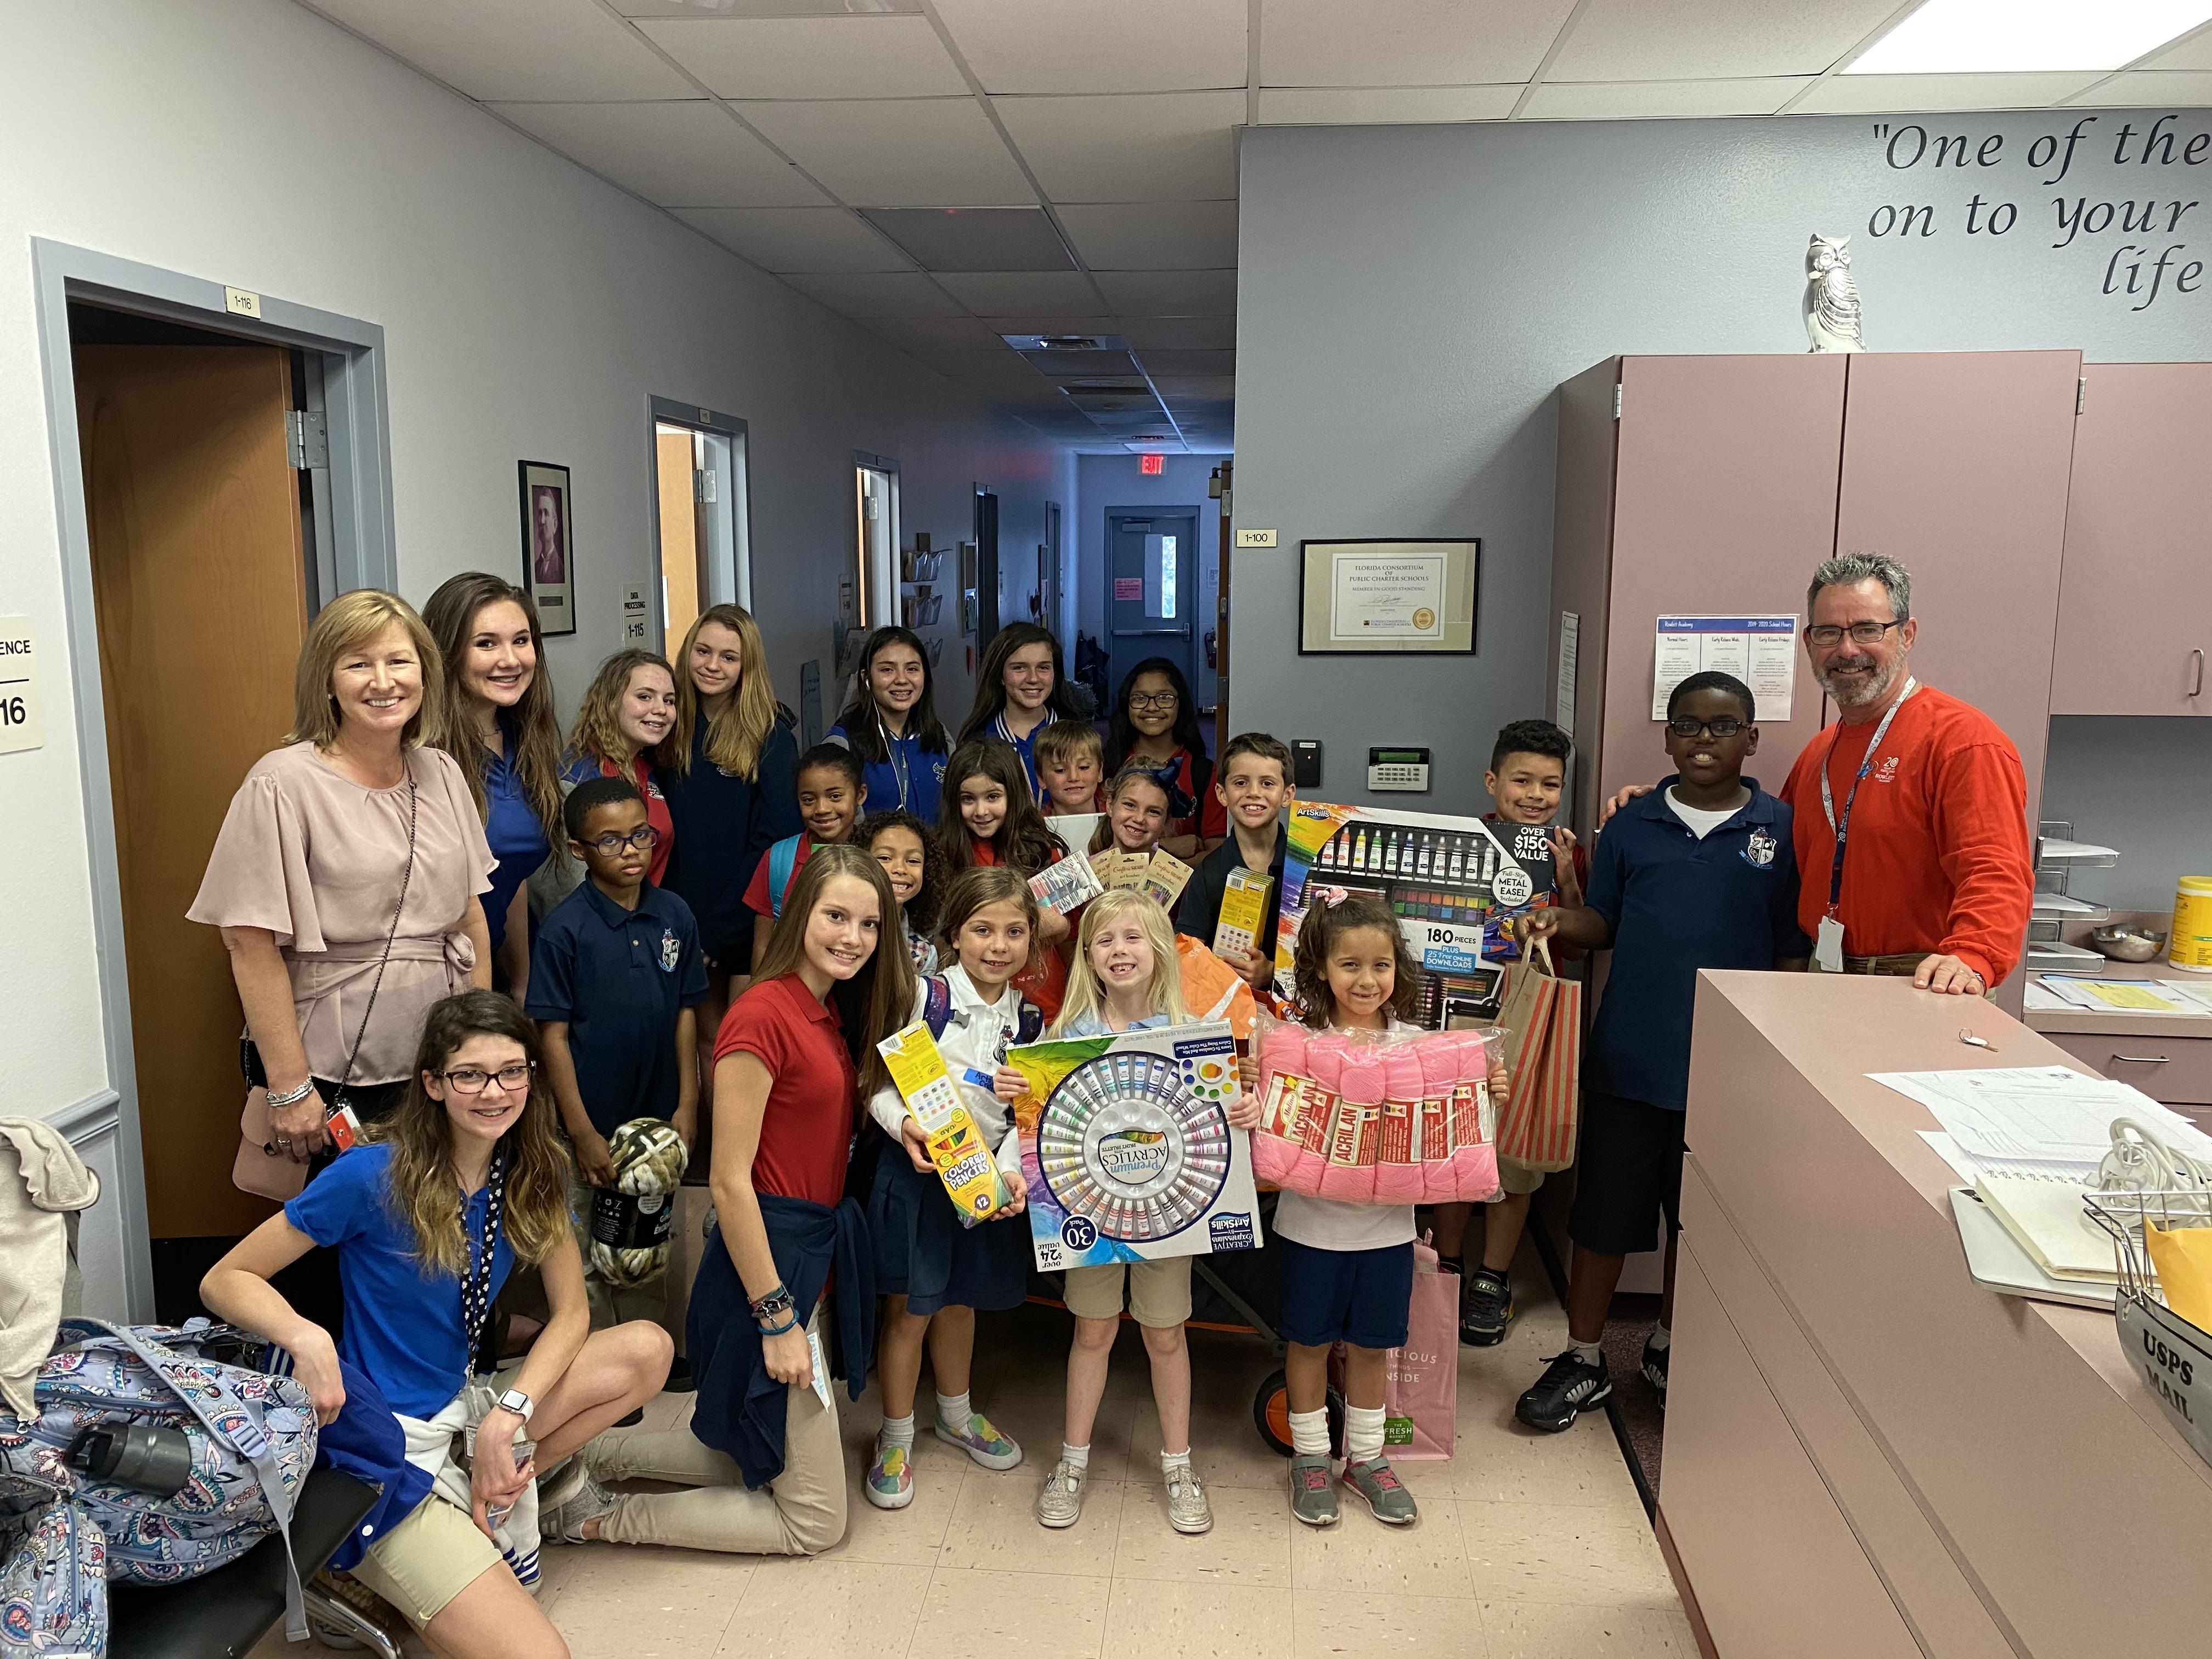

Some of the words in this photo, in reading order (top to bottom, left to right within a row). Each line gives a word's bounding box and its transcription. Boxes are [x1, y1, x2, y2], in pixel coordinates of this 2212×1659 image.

[1874, 123, 2004, 169] "One
[2028, 117, 2097, 185] of
[2114, 115, 2211, 165] the
[1869, 205, 1937, 237] on
[1966, 194, 2017, 235] to
[2052, 197, 2199, 248] your
[2103, 245, 2203, 311] life
[235, 295, 251, 309] 1-116
[1142, 456, 1163, 475] EXIT
[1245, 533, 1268, 542] 1-100
[628, 623, 644, 637] 1-115
[1297, 808, 1329, 818] ArtSkills
[1521, 827, 1545, 836] OVER
[1515, 834, 1548, 851] $150
[1514, 849, 1549, 861] VALUE
[1499, 878, 1527, 887] METAL
[1500, 887, 1526, 896] EASEL
[1427, 928, 1453, 944] 180
[1427, 958, 1472, 969] DOWNLOADS
[1292, 1085, 1317, 1138] ACRILAN
[1336, 1107, 1357, 1162] ACRILAN
[1102, 1147, 1166, 1166] ACRYLICS
[943, 1151, 987, 1182] COLORED
[1110, 1159, 1161, 1174] Premium
[950, 1162, 990, 1191] PENCILS
[976, 1196, 989, 1208] 12
[1211, 1218, 1249, 1229] ArtSkills
[1066, 1226, 1092, 1246] 30
[1212, 1233, 1252, 1243] Expressions
[1037, 1243, 1059, 1251] value
[1213, 1241, 1249, 1250] CREATIVE
[1040, 1249, 1062, 1261] $24
[1386, 1350, 1437, 1364] ICIOUS
[2143, 1329, 2193, 1386] USPS
[1386, 1372, 1420, 1383] NSIDE
[2146, 1364, 2193, 1424] MAIL
